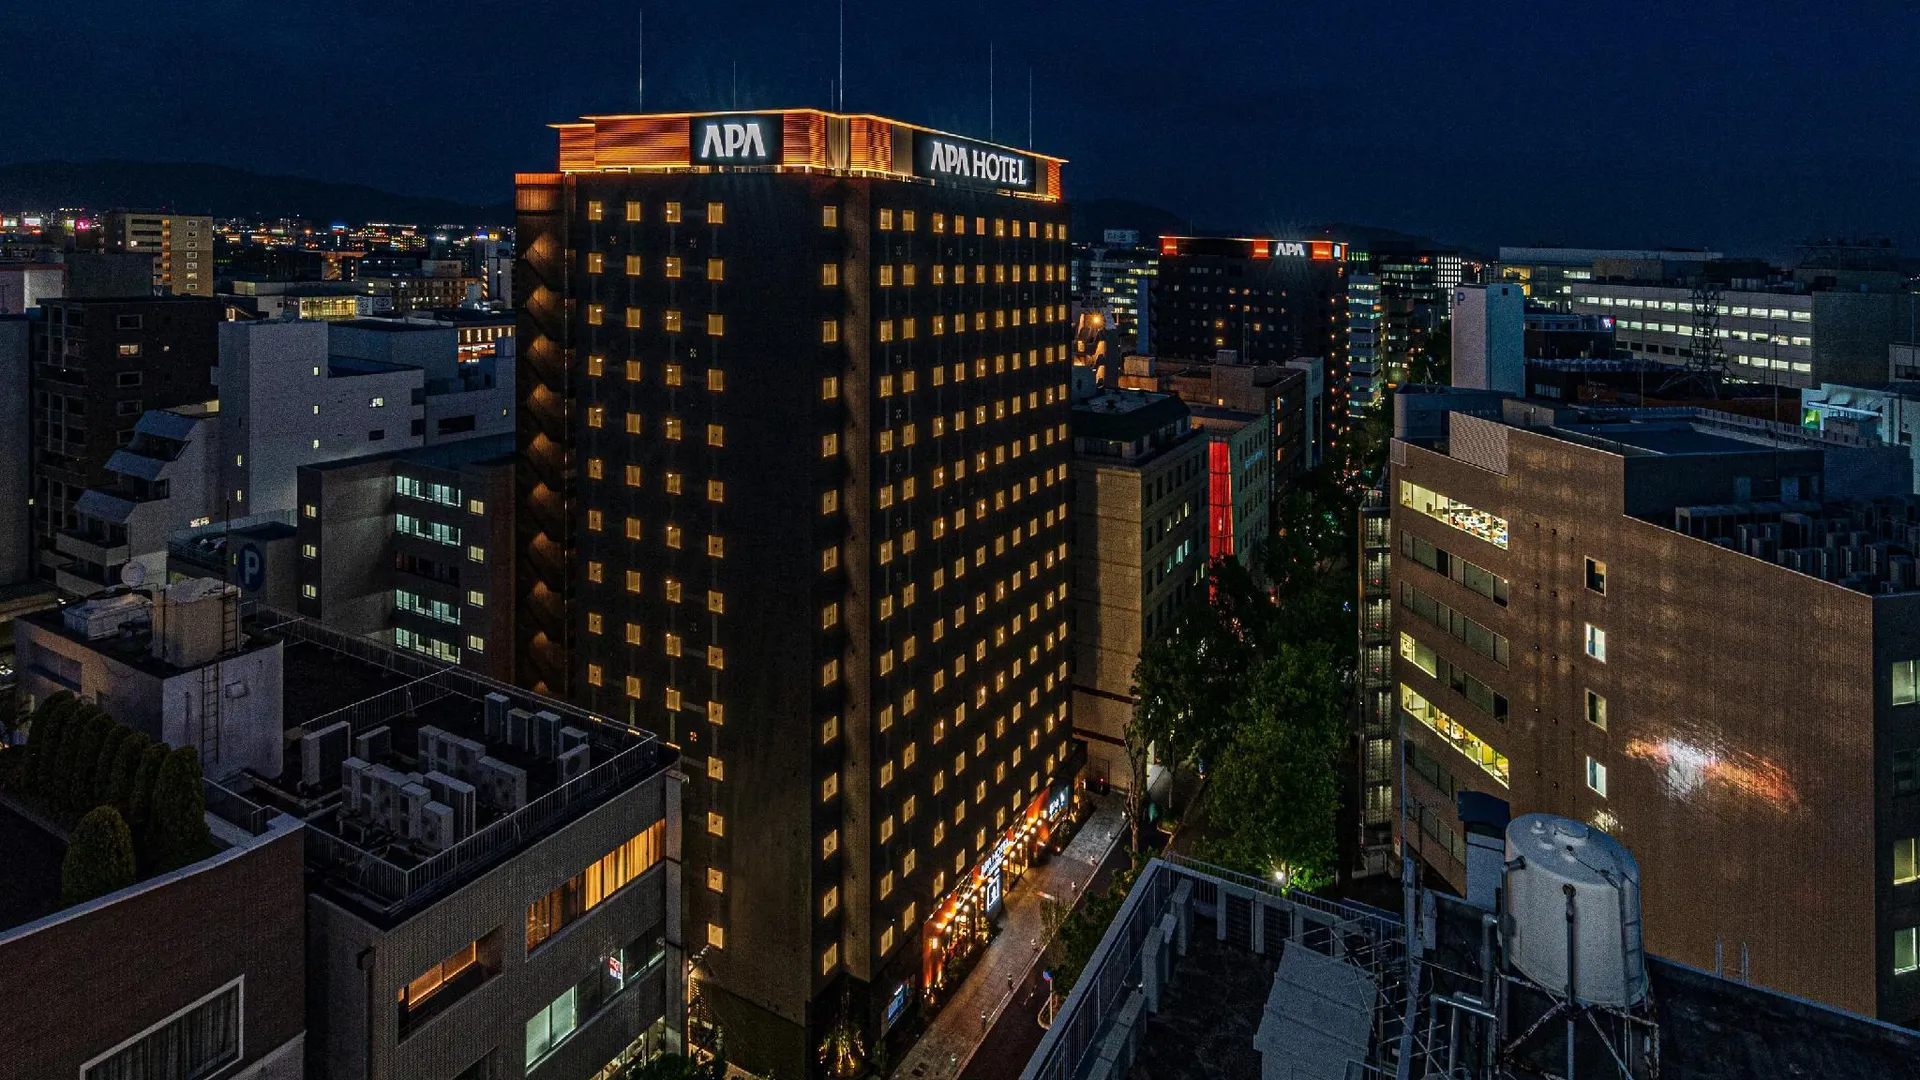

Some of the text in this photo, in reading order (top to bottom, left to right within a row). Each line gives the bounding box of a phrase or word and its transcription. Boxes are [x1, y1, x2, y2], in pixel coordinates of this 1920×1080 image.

[701, 123, 766, 158] APA
[931, 141, 1027, 185] APA HOTEL
[1275, 243, 1305, 256] APA
[1457, 292, 1465, 306] P
[244, 550, 260, 585] P
